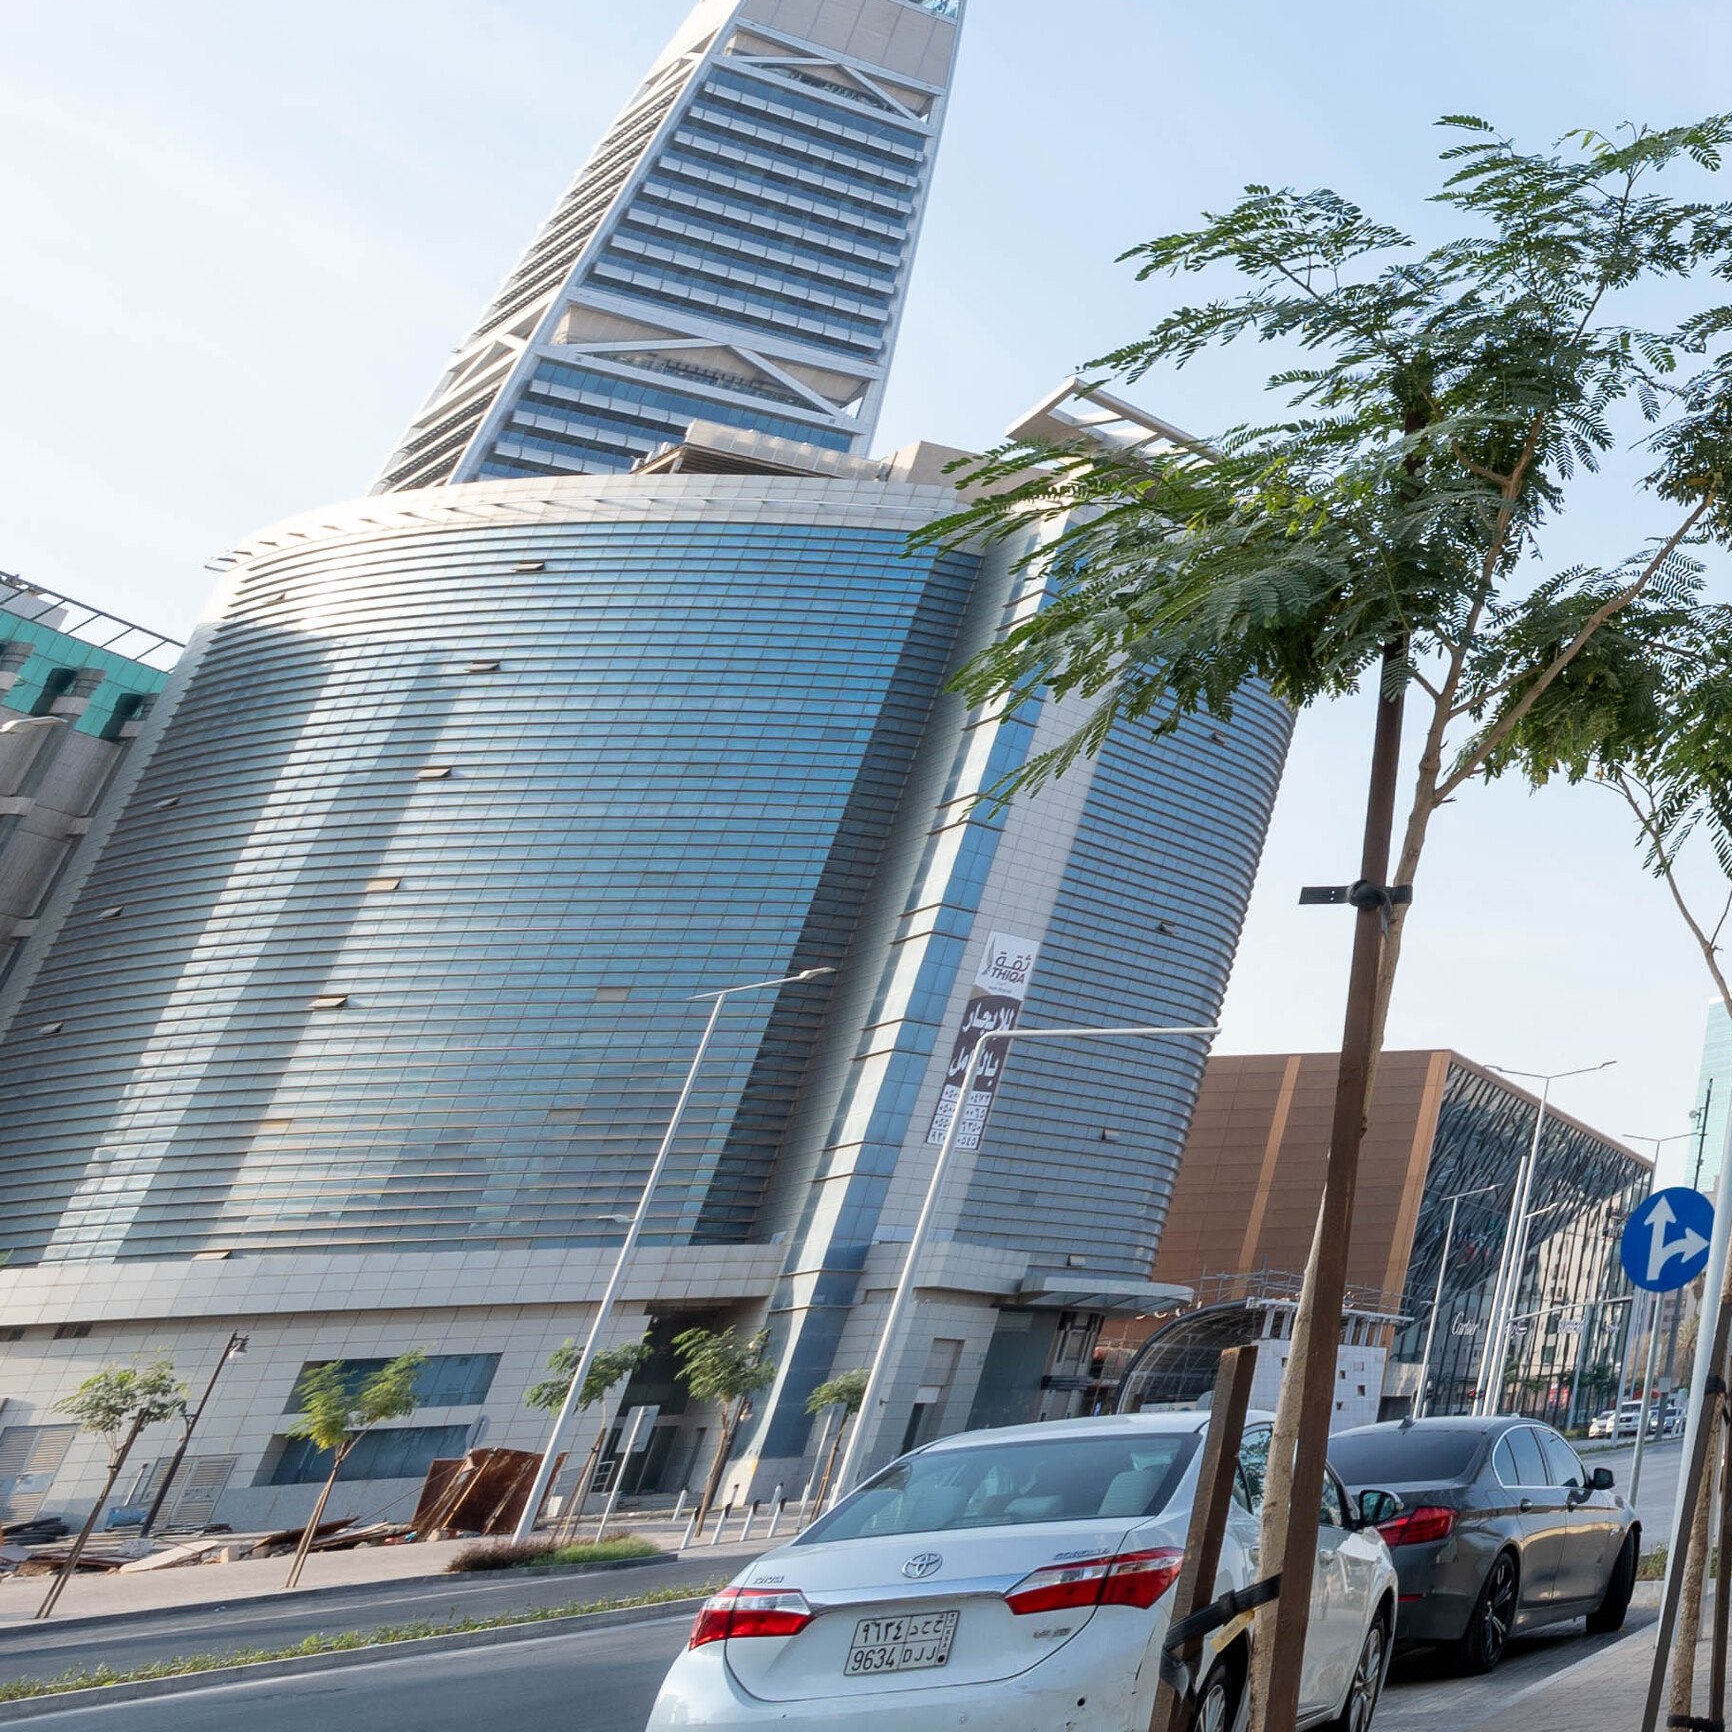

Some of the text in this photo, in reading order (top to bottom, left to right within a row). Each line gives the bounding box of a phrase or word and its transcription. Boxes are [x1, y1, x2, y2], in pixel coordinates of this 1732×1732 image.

[995, 951, 1032, 972] ثقة
[990, 966, 1025, 984] THIQA
[1452, 1311, 1480, 1335] Cartier
[862, 1620, 903, 1643] ٩٦٣٤
[851, 1646, 937, 1671] 9634 DJJ
